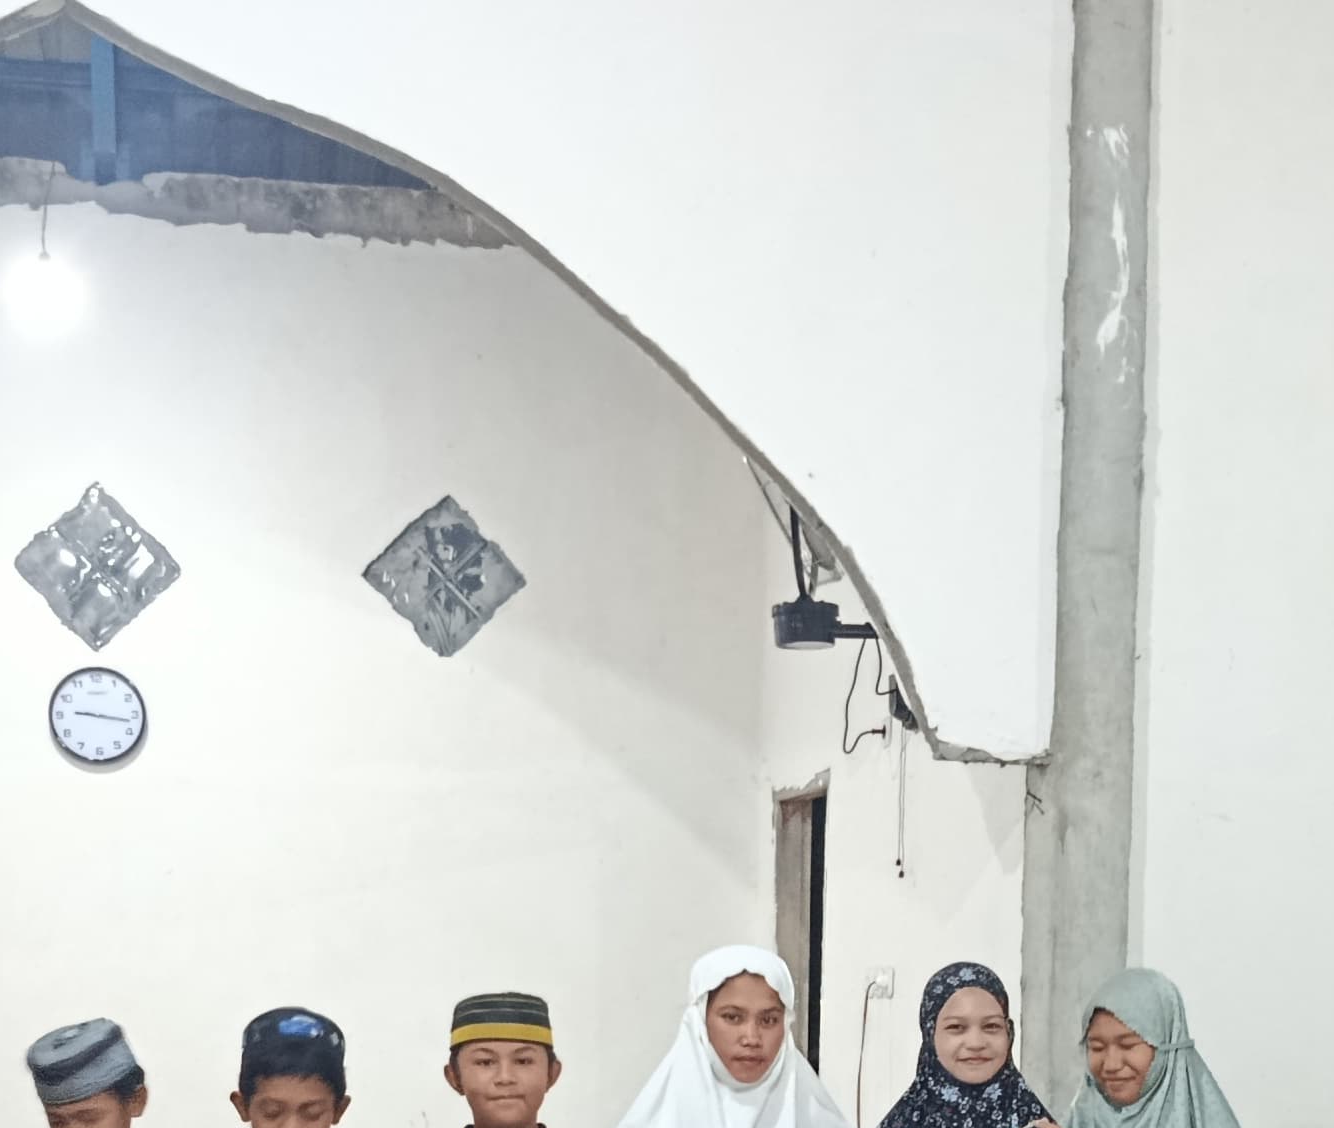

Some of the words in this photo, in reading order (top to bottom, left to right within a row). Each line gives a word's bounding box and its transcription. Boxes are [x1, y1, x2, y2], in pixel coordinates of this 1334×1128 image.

[72, 680, 83, 688] 11
[60, 694, 73, 703] 10
[124, 693, 133, 703] 2
[56, 710, 64, 720] 9
[131, 710, 139, 720] 3
[63, 728, 72, 738] 8
[125, 727, 134, 736] 4
[77, 741, 85, 750] 7
[113, 740, 122, 750] 5
[95, 746, 104, 756] 6
